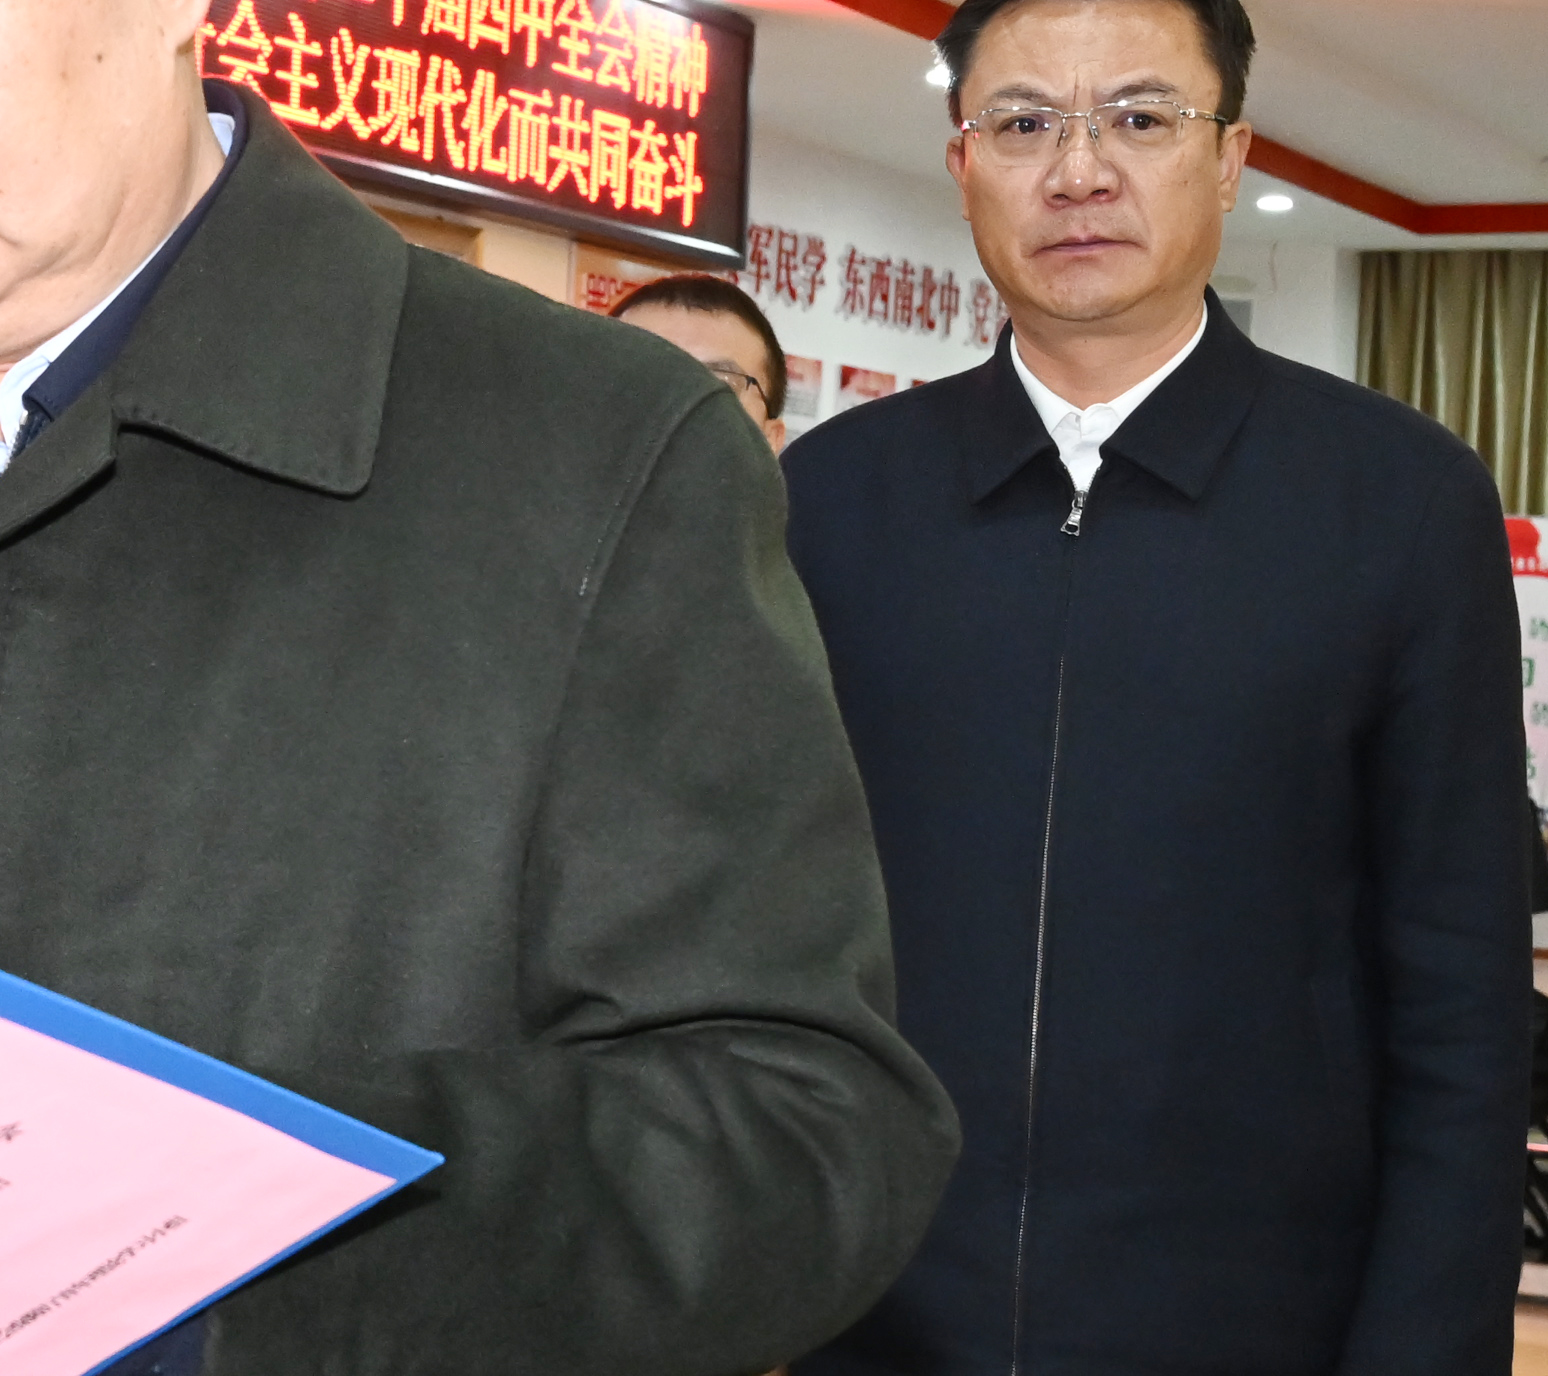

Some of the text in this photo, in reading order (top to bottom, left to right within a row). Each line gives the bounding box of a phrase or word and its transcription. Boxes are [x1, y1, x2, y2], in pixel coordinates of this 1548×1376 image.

[841, 245, 961, 340] 东西南北中
